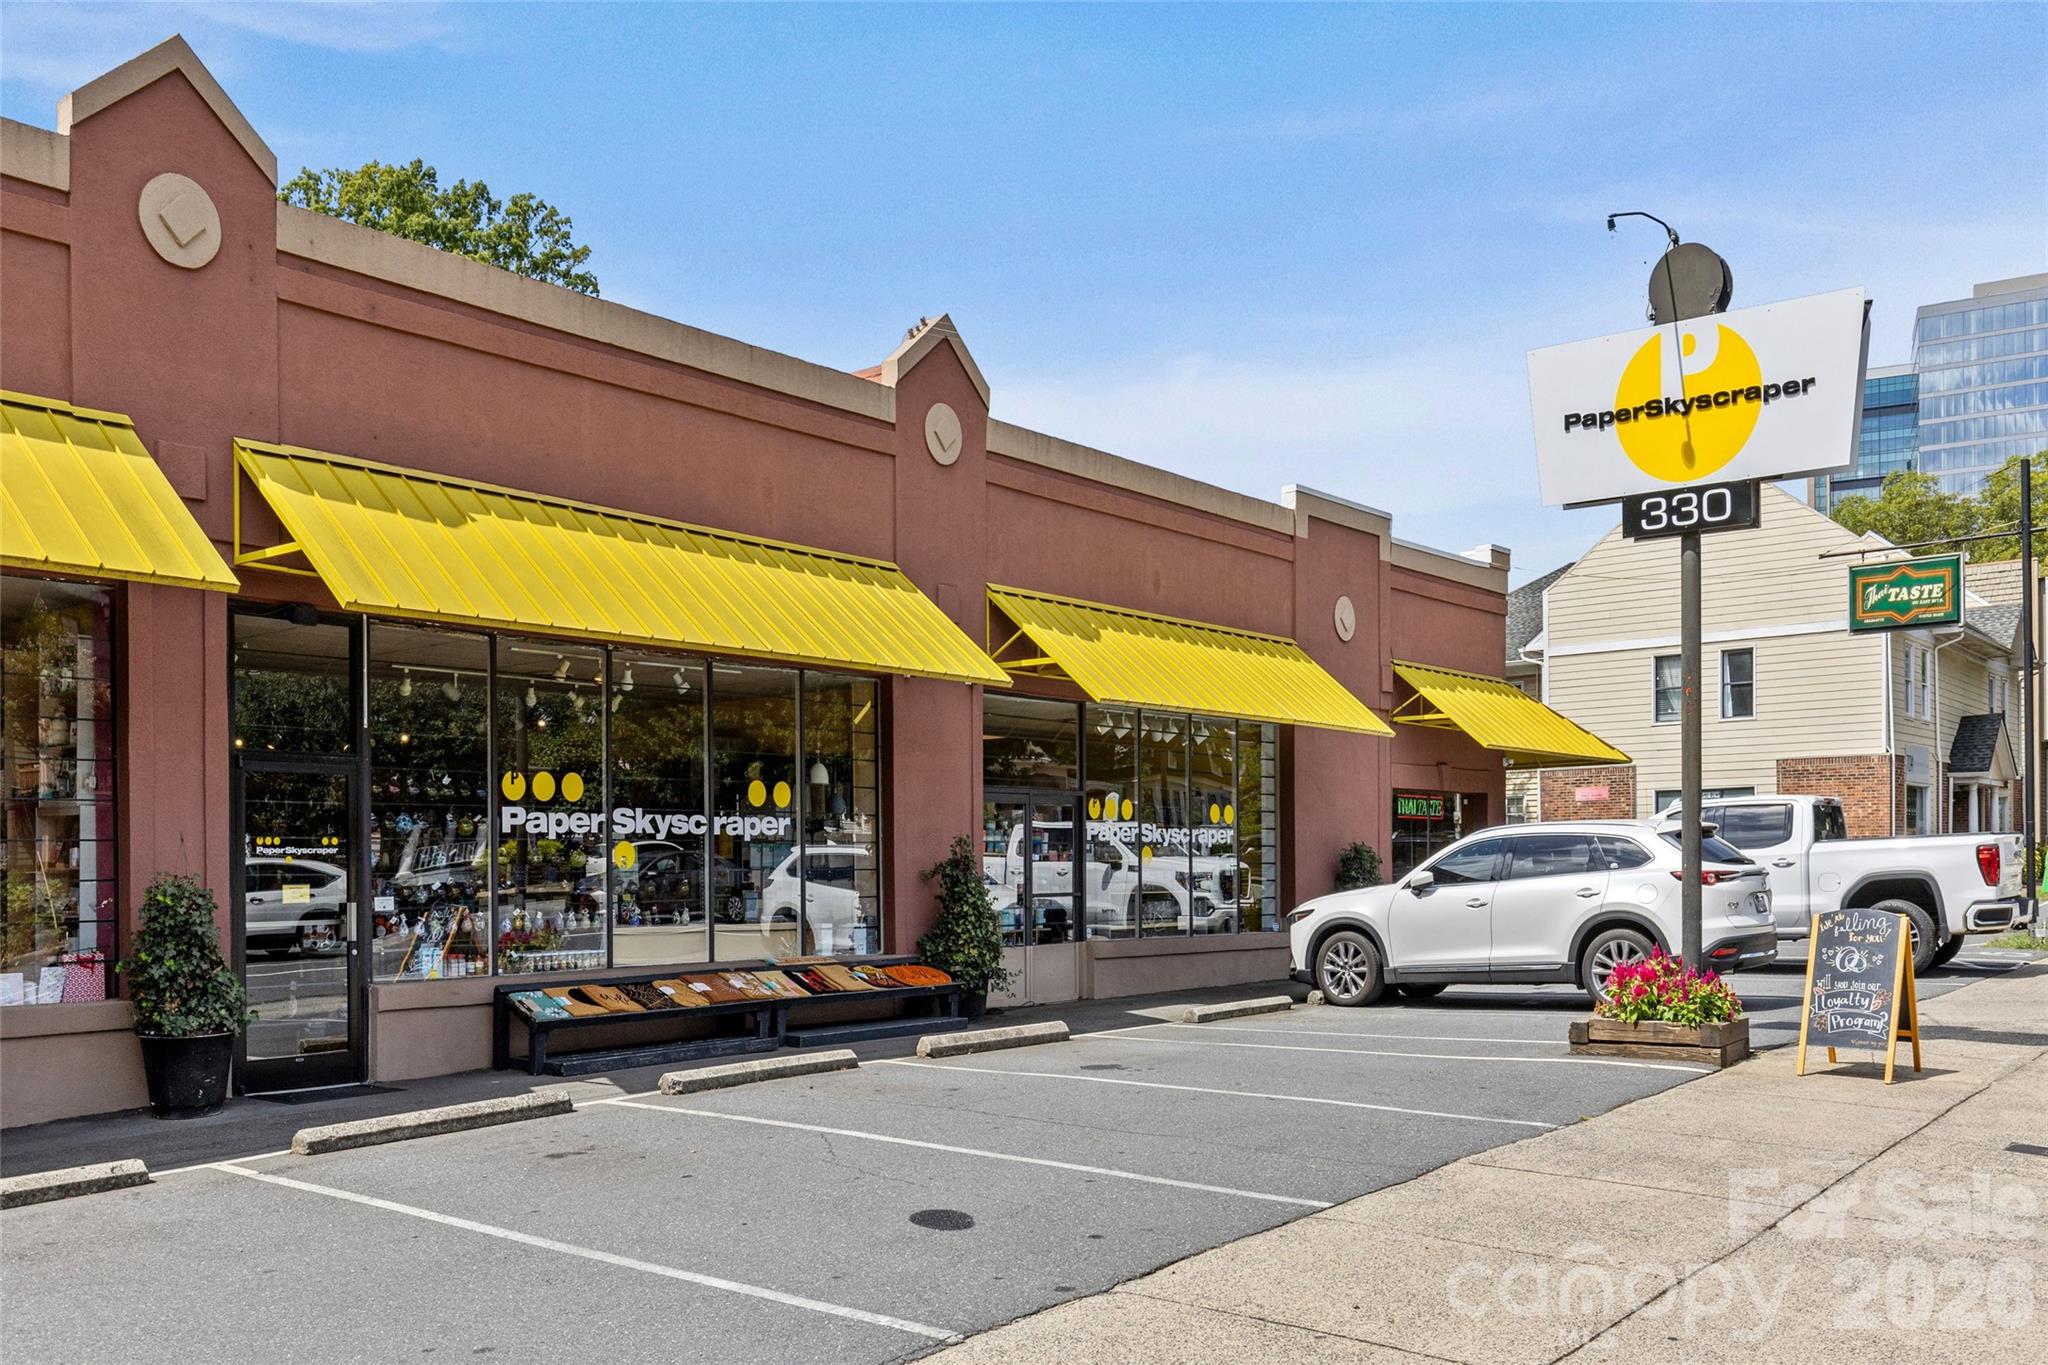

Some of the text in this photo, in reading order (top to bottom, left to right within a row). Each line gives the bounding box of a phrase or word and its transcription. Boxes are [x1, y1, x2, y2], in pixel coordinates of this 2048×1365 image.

[1564, 376, 1816, 433] PaperSkyscraper
[1641, 488, 1732, 531] 330
[1864, 583, 1944, 610] Thai TASTE
[1398, 798, 1416, 815] THAI
[1834, 912, 1892, 937] falling
[1834, 981, 1848, 990] you
